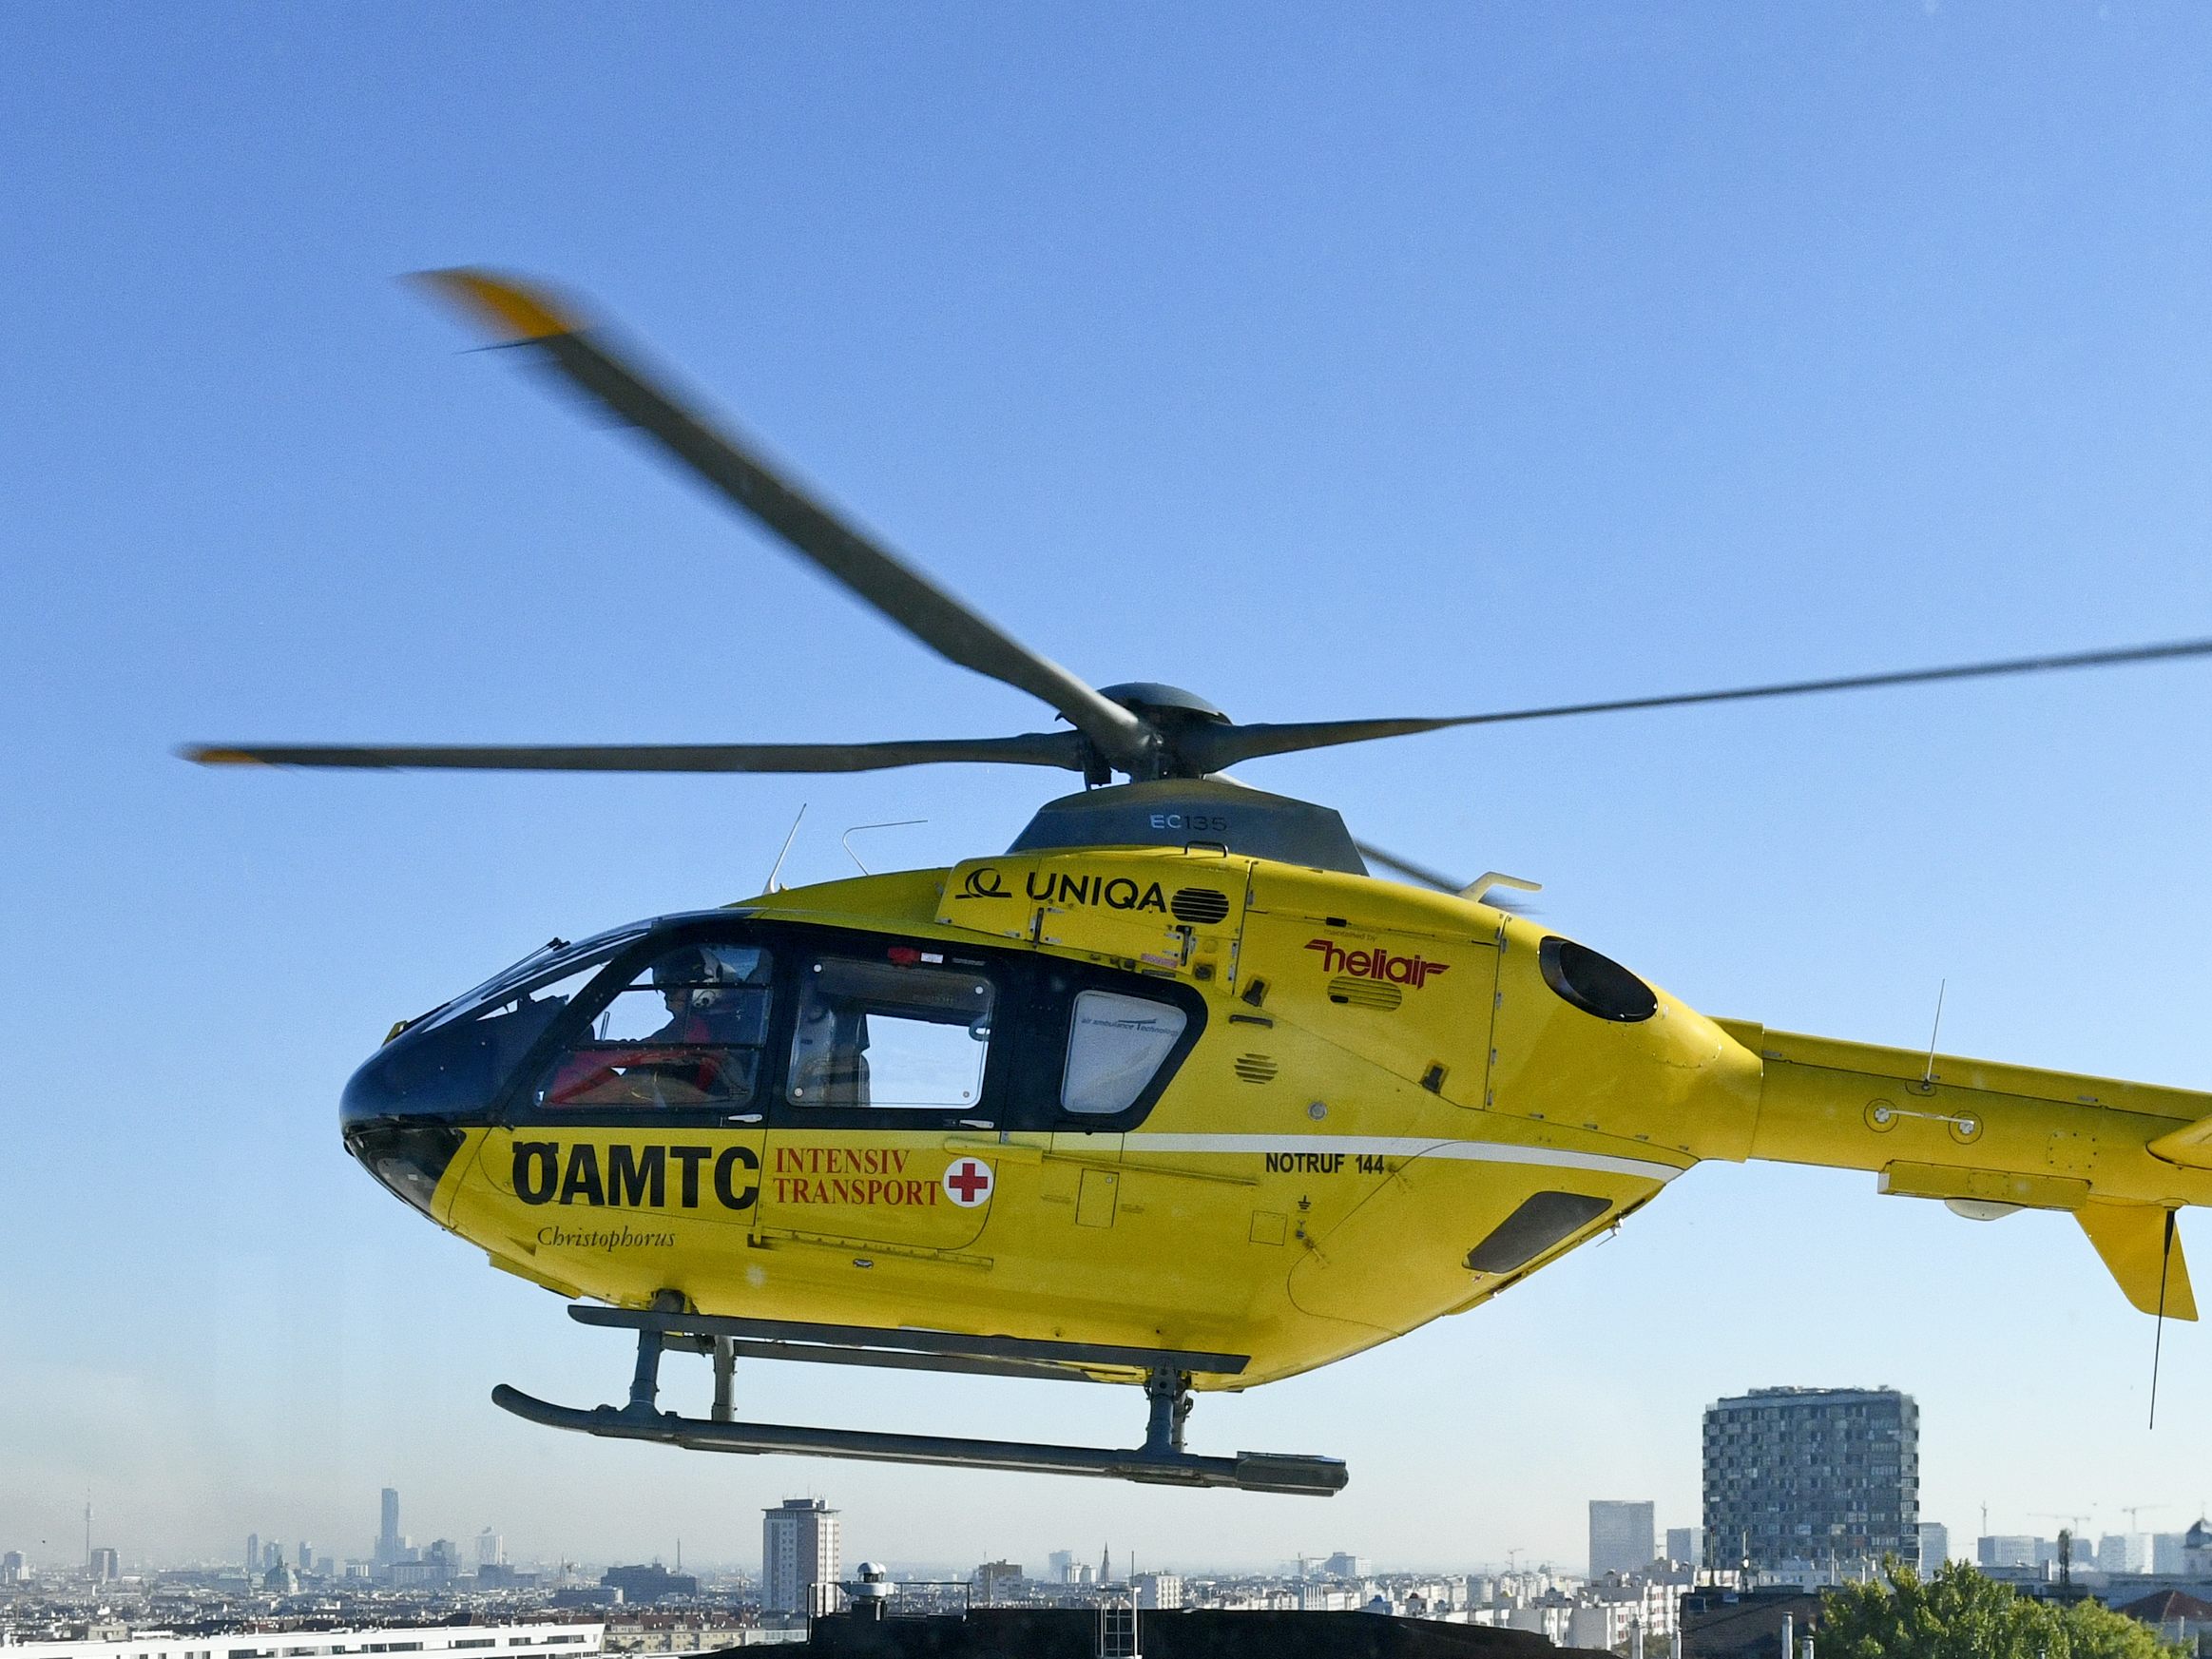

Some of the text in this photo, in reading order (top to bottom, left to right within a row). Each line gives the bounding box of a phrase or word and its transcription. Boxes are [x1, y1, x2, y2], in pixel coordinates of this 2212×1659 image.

[1150, 814, 1227, 832] EC135
[1027, 872, 1166, 913] UNIQA
[1304, 938, 1451, 990] heliair
[1092, 1019, 1134, 1030] ambulance
[1136, 1019, 1179, 1037] Technology
[775, 1148, 910, 1174] INTENSIV
[1265, 1152, 1385, 1175] NOTRUF 144
[511, 1141, 759, 1209] ÖAMTC
[772, 1178, 941, 1206] TRANSPORT
[537, 1225, 675, 1252] Christophorus
